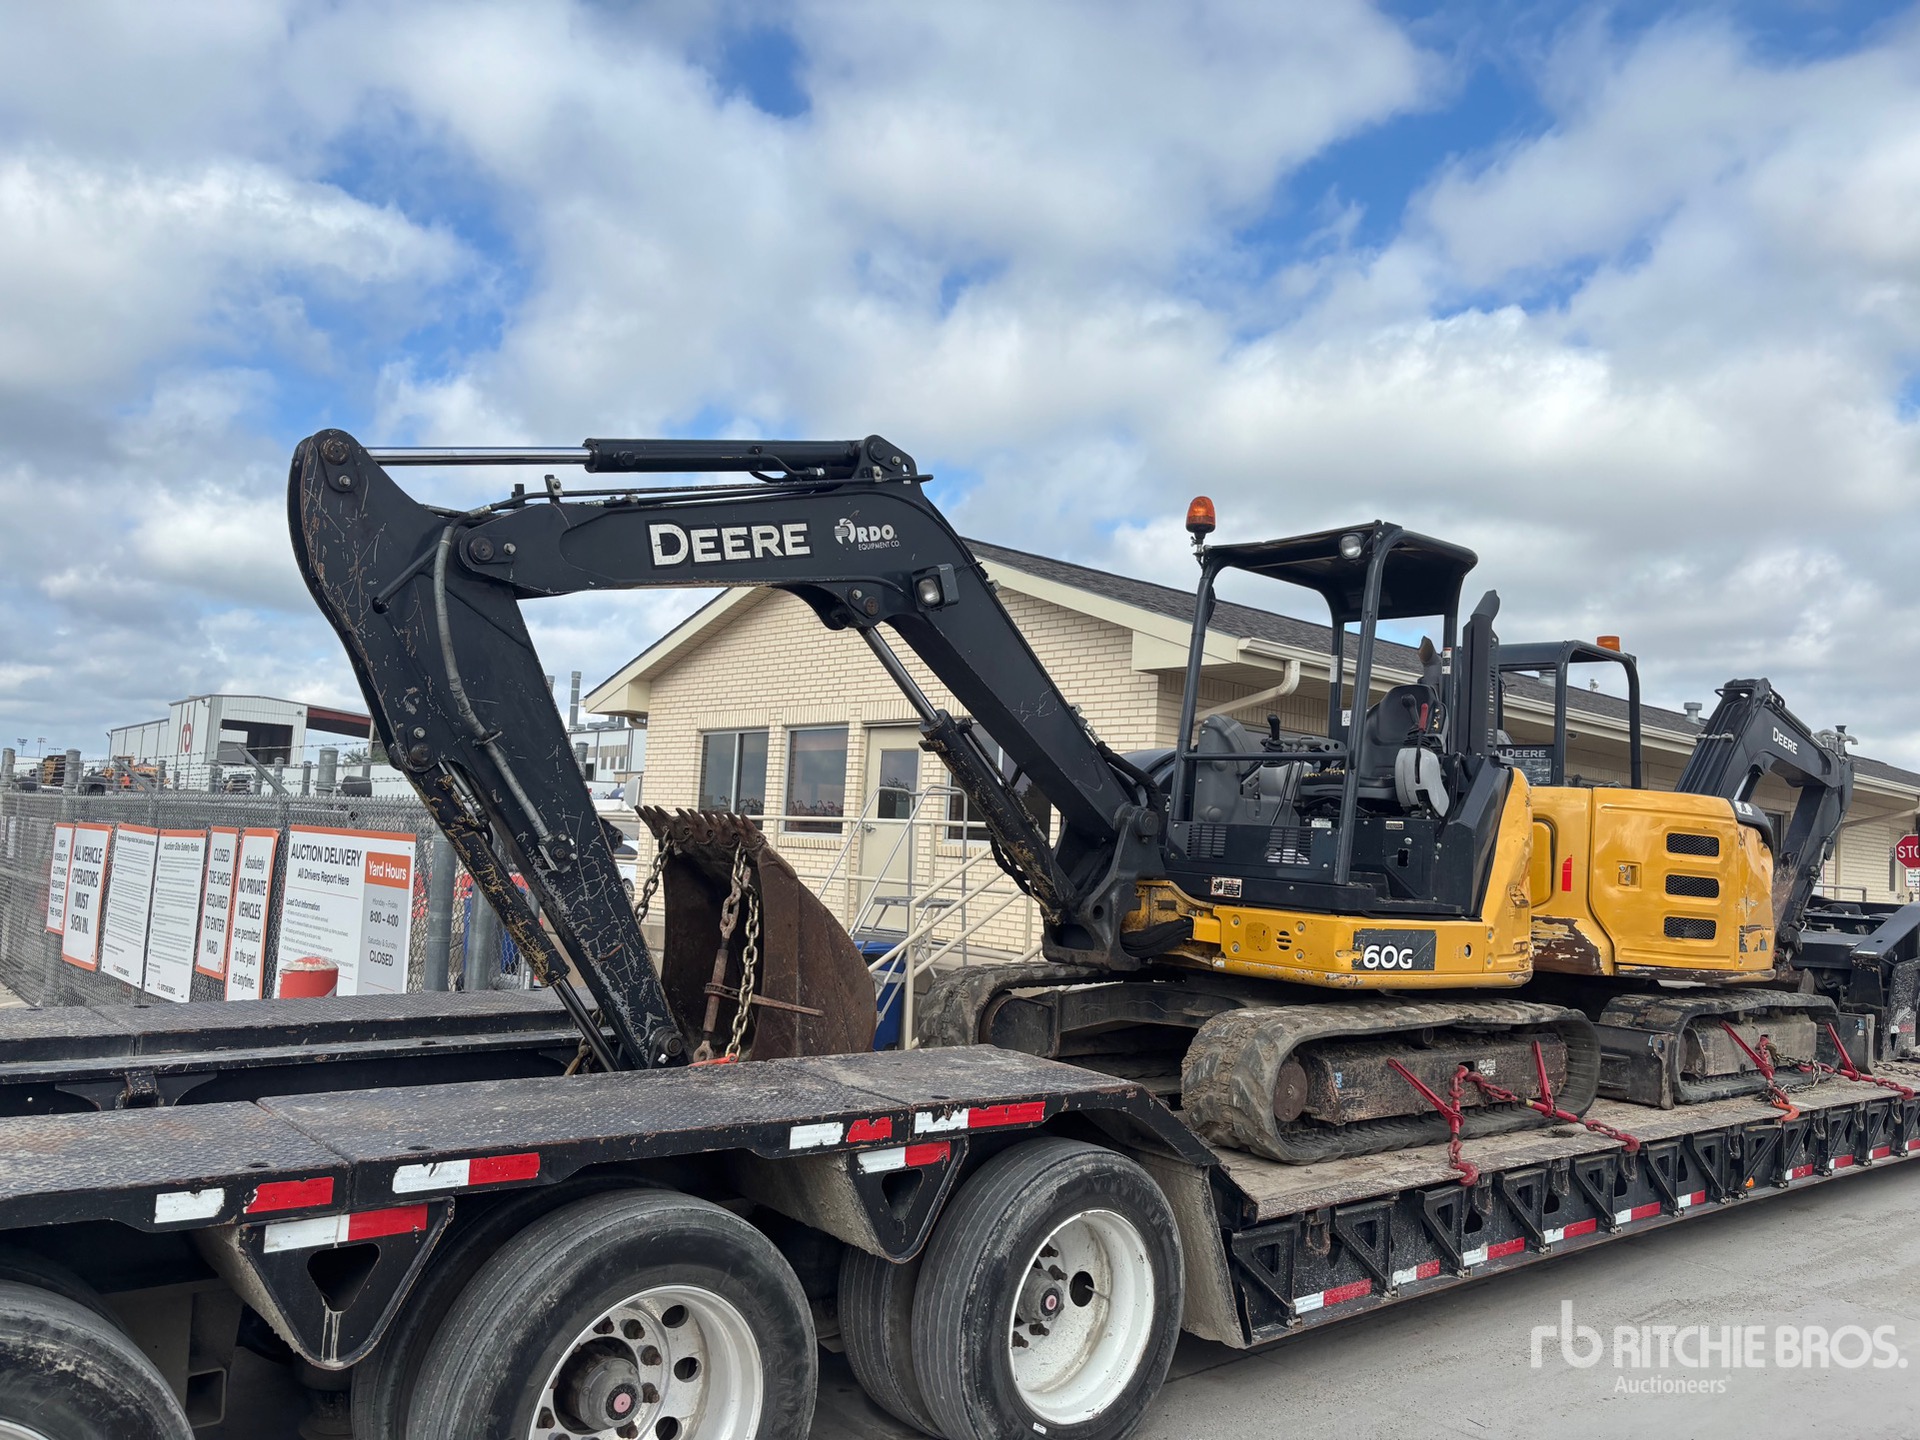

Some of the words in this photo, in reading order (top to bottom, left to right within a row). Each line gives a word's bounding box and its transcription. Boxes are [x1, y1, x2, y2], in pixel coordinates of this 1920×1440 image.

[649, 523, 810, 566] DEERE
[858, 541, 890, 550] EQUIPMENT
[1772, 726, 1798, 755] DEERE
[1506, 748, 1546, 758] DEERE
[82, 846, 102, 864] VEHICLE
[164, 842, 174, 850] Auction
[214, 848, 230, 862] CLOSED
[291, 843, 324, 861] AUCTION
[324, 847, 362, 867] DELIVERY
[1898, 846, 1919, 858] STO
[245, 855, 265, 874] Absolutely
[368, 860, 384, 876] Yard
[385, 863, 407, 880] Hours
[72, 868, 99, 888] OPERATORS
[209, 870, 217, 884] TOE
[217, 871, 231, 886] SHOES
[305, 868, 320, 881] Drivers
[321, 870, 337, 885] Report
[338, 873, 350, 886] Here
[238, 877, 246, 893] NO
[247, 878, 267, 896] PRIVATE
[75, 891, 89, 910] MUST
[206, 893, 228, 909] REQUIRED
[286, 898, 295, 906] Load
[302, 901, 320, 911] Information
[239, 901, 261, 920] VEHICLES
[370, 910, 381, 923] 8:00
[387, 913, 399, 927] 4:00
[71, 914, 81, 932] SIGN
[205, 915, 210, 929] TO
[210, 917, 225, 933] ENTER
[241, 927, 261, 943] permitted
[206, 939, 218, 954] YARD
[246, 951, 256, 968] yard
[370, 950, 394, 966] CLOSED
[1363, 945, 1413, 969] 60G
